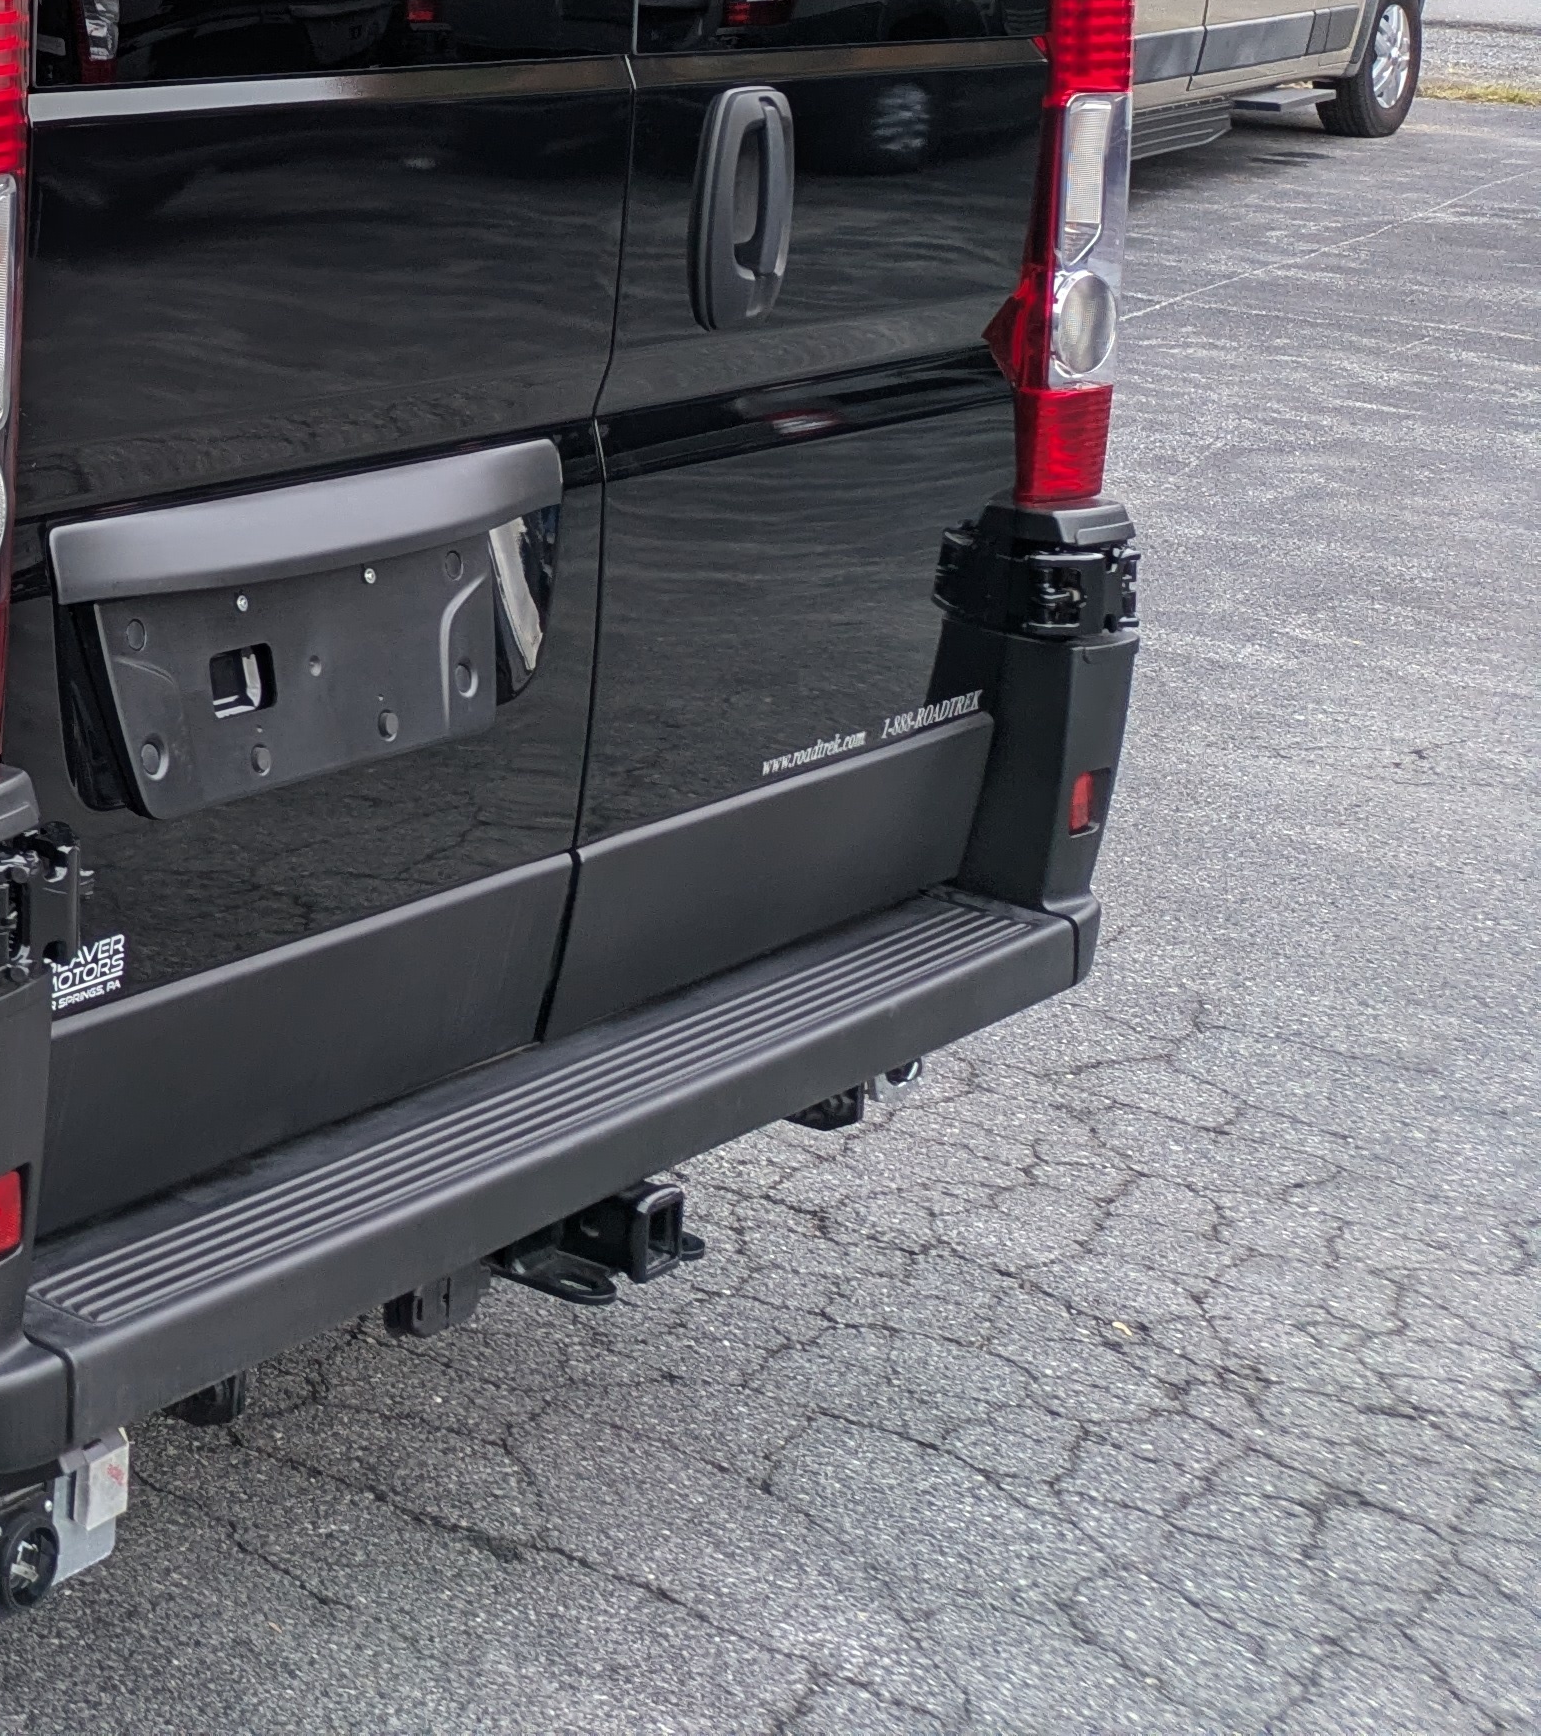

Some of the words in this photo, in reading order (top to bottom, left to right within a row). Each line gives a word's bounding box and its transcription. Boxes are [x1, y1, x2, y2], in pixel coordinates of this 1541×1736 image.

[761, 730, 866, 776] www.roadtrek.com
[881, 689, 984, 739] 1-888-ROADTREK
[50, 934, 125, 973] AVER
[52, 953, 125, 992] OTORS
[58, 984, 105, 1009] SPRINGS,
[106, 979, 121, 992] PA
